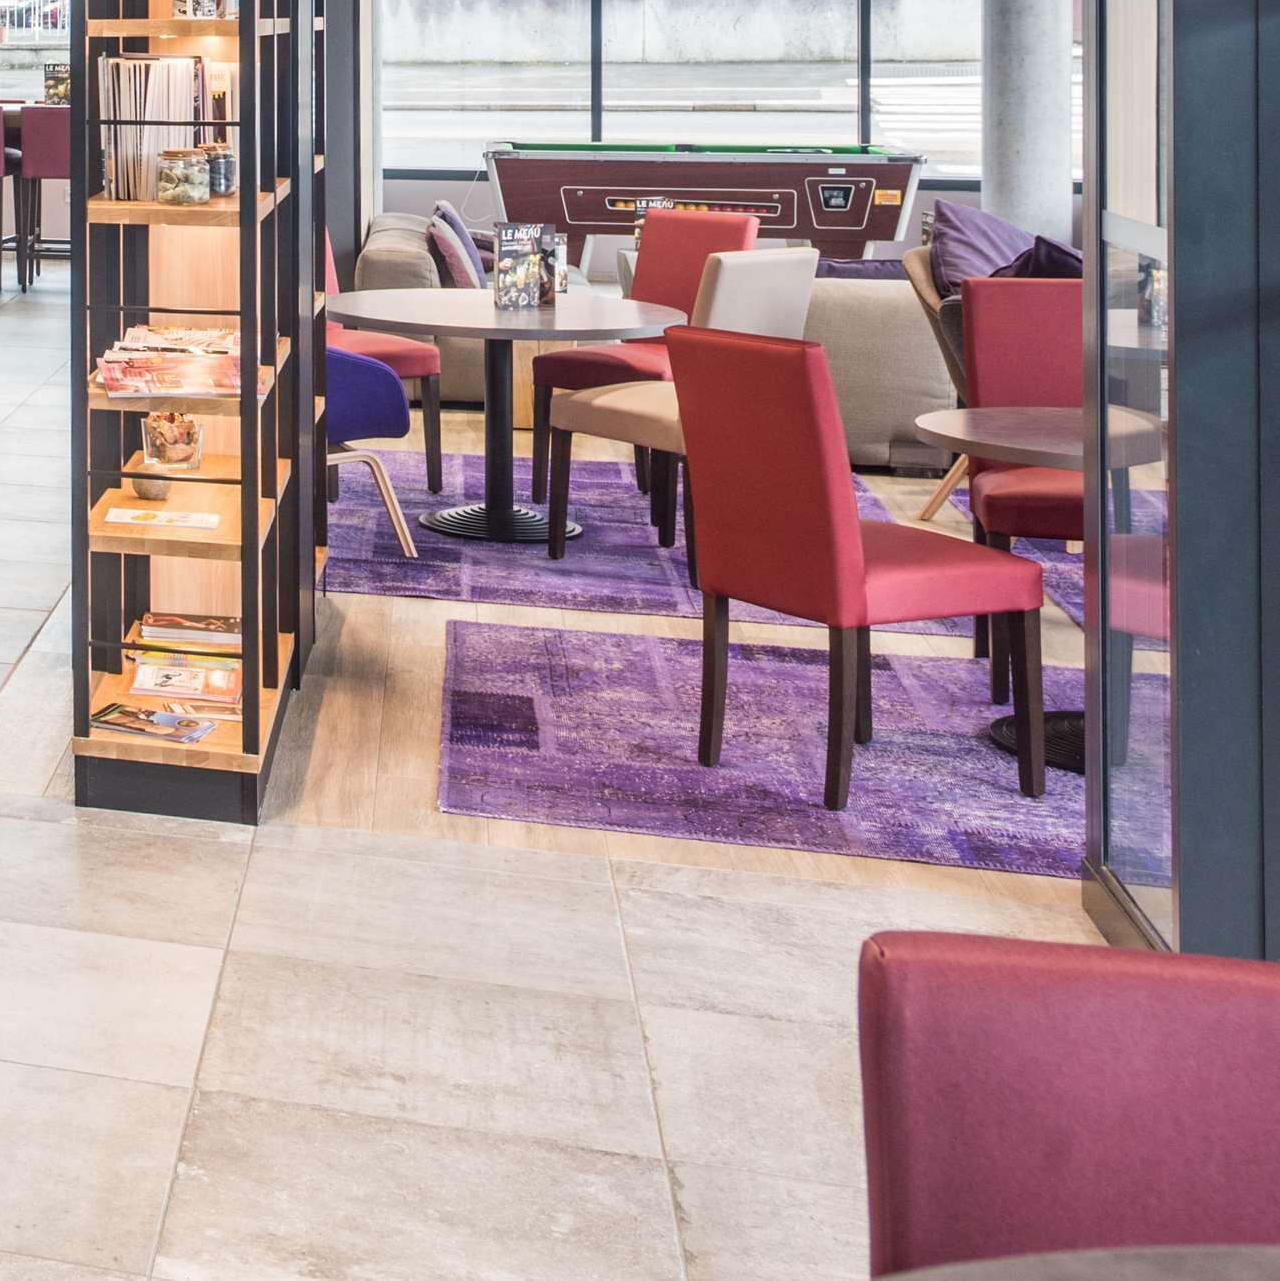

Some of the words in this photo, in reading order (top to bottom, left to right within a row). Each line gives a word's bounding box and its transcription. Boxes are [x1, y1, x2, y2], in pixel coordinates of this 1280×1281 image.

[636, 200, 647, 208] LE
[648, 200, 674, 209] MENU
[502, 229, 513, 240] LE
[514, 227, 541, 240] MENU
